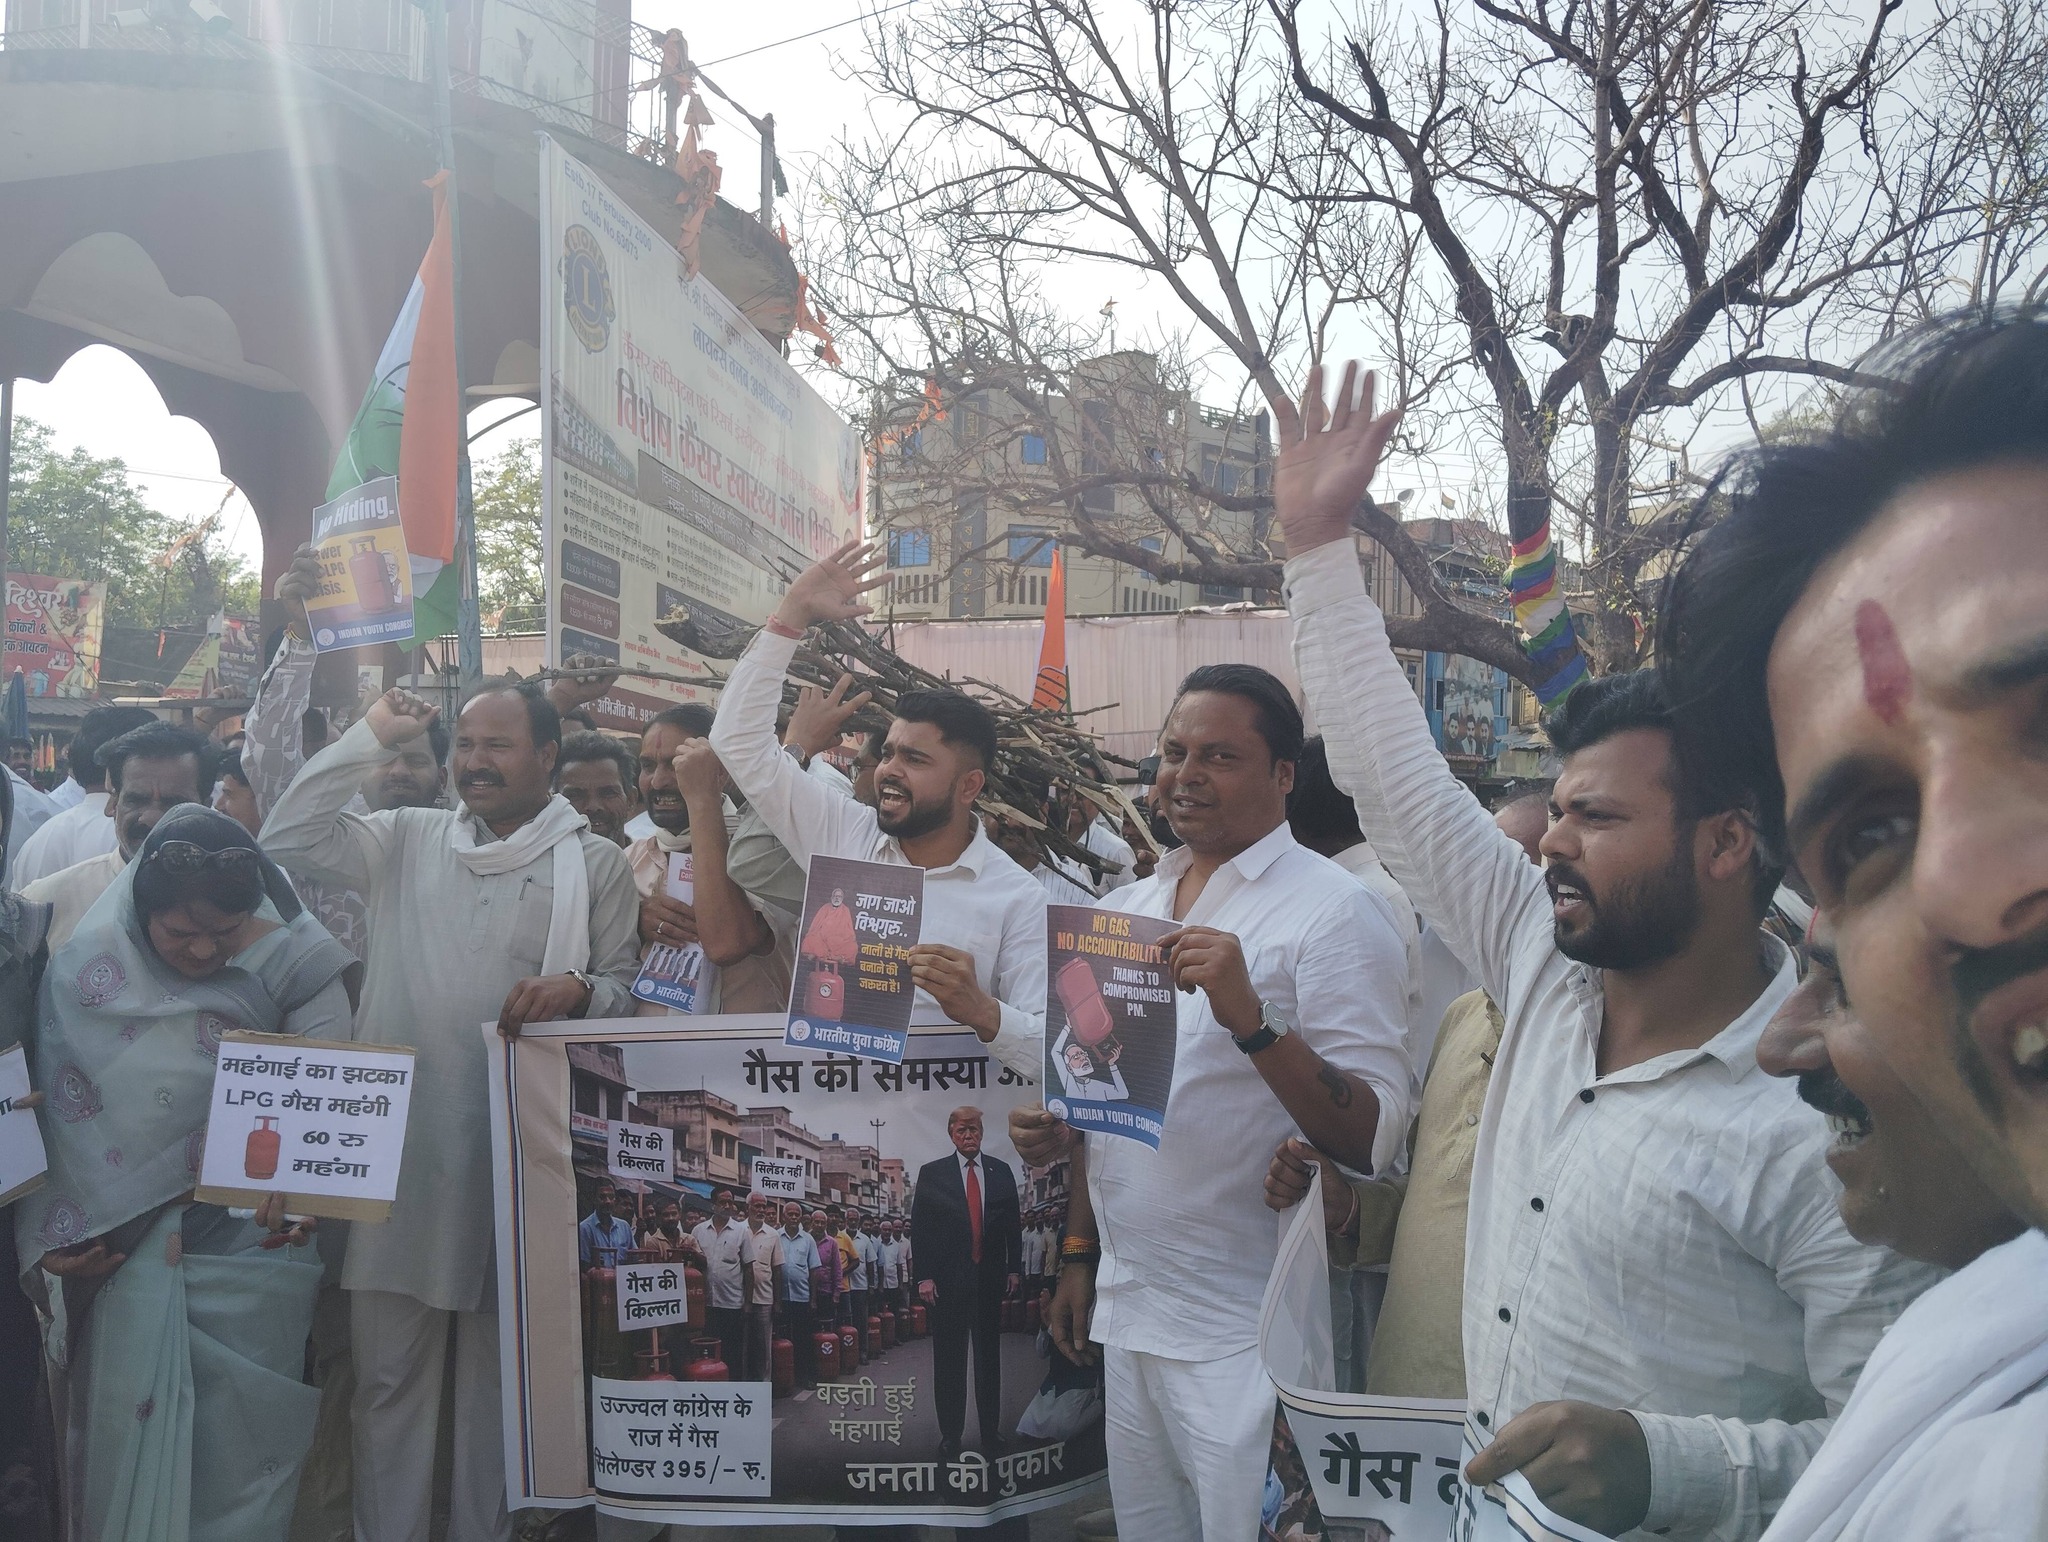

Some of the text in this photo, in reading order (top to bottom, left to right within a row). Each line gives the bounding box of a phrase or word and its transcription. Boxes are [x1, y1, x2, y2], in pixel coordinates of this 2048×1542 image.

[581, 199, 601, 228] Club
[692, 322, 726, 371] लायन्स
[623, 331, 650, 374] कैंसर
[652, 356, 694, 407] हॉस्पिटल
[695, 393, 709, 418] एवं
[710, 397, 733, 436] रिसर्च
[616, 368, 671, 456] विशेष
[678, 410, 722, 488] कैंसर
[726, 458, 776, 525] स्वास्थ्य
[317, 496, 394, 538] No Hiding.
[324, 562, 346, 577] LPG
[9, 618, 47, 635] क्रॉकरी &
[338, 619, 412, 639] INDIAN YOUTH CONGRESS
[597, 697, 626, 718] अभिजीत
[628, 702, 638, 720] मो.
[855, 893, 916, 916] जाग जाओ
[1092, 914, 1132, 937] NO GAS.
[861, 943, 910, 960] नाली से गैस
[1057, 932, 1168, 964] NO ACCOUNTABILITY.
[860, 960, 898, 976] बनाने की
[1112, 966, 1160, 986] THANKS TO
[656, 985, 688, 1005] भारतीय
[859, 978, 888, 992] जरूरत
[1103, 981, 1171, 1004] COMPROMISED
[1127, 1002, 1147, 1018] PM.
[814, 1026, 900, 1054] भारतीय युवा कांग्रेस
[222, 1054, 408, 1085] महंगाई का झटका
[742, 1048, 803, 1093] गैस
[812, 1052, 862, 1092] की
[871, 1056, 989, 1093] समस्या
[225, 1088, 392, 1117] LPG गैस महंगी
[1072, 1107, 1104, 1122] INDIAN
[1106, 1110, 1133, 1127] YOUTH
[303, 1130, 368, 1147] 60 रु
[619, 1128, 664, 1151] गैस की
[292, 1157, 371, 1178] महंगा
[617, 1150, 666, 1172] किल्लत
[755, 1160, 803, 1178] सिलेंडर नहीं
[761, 1176, 796, 1191] मिल रहा
[626, 1269, 678, 1293] गैस की
[624, 1297, 681, 1320] किल्लत
[600, 1393, 752, 1418] उज्ज्वल कांग्रेस के
[883, 1377, 916, 1413] हुई
[628, 1423, 720, 1448] राज में गैस
[829, 1412, 903, 1446] मंहगाई
[594, 1447, 656, 1478] सिलेण्डर
[742, 1461, 766, 1480] रु.
[846, 1441, 1066, 1496] जनता की पुकार
[1319, 1431, 1421, 1504] गैस
